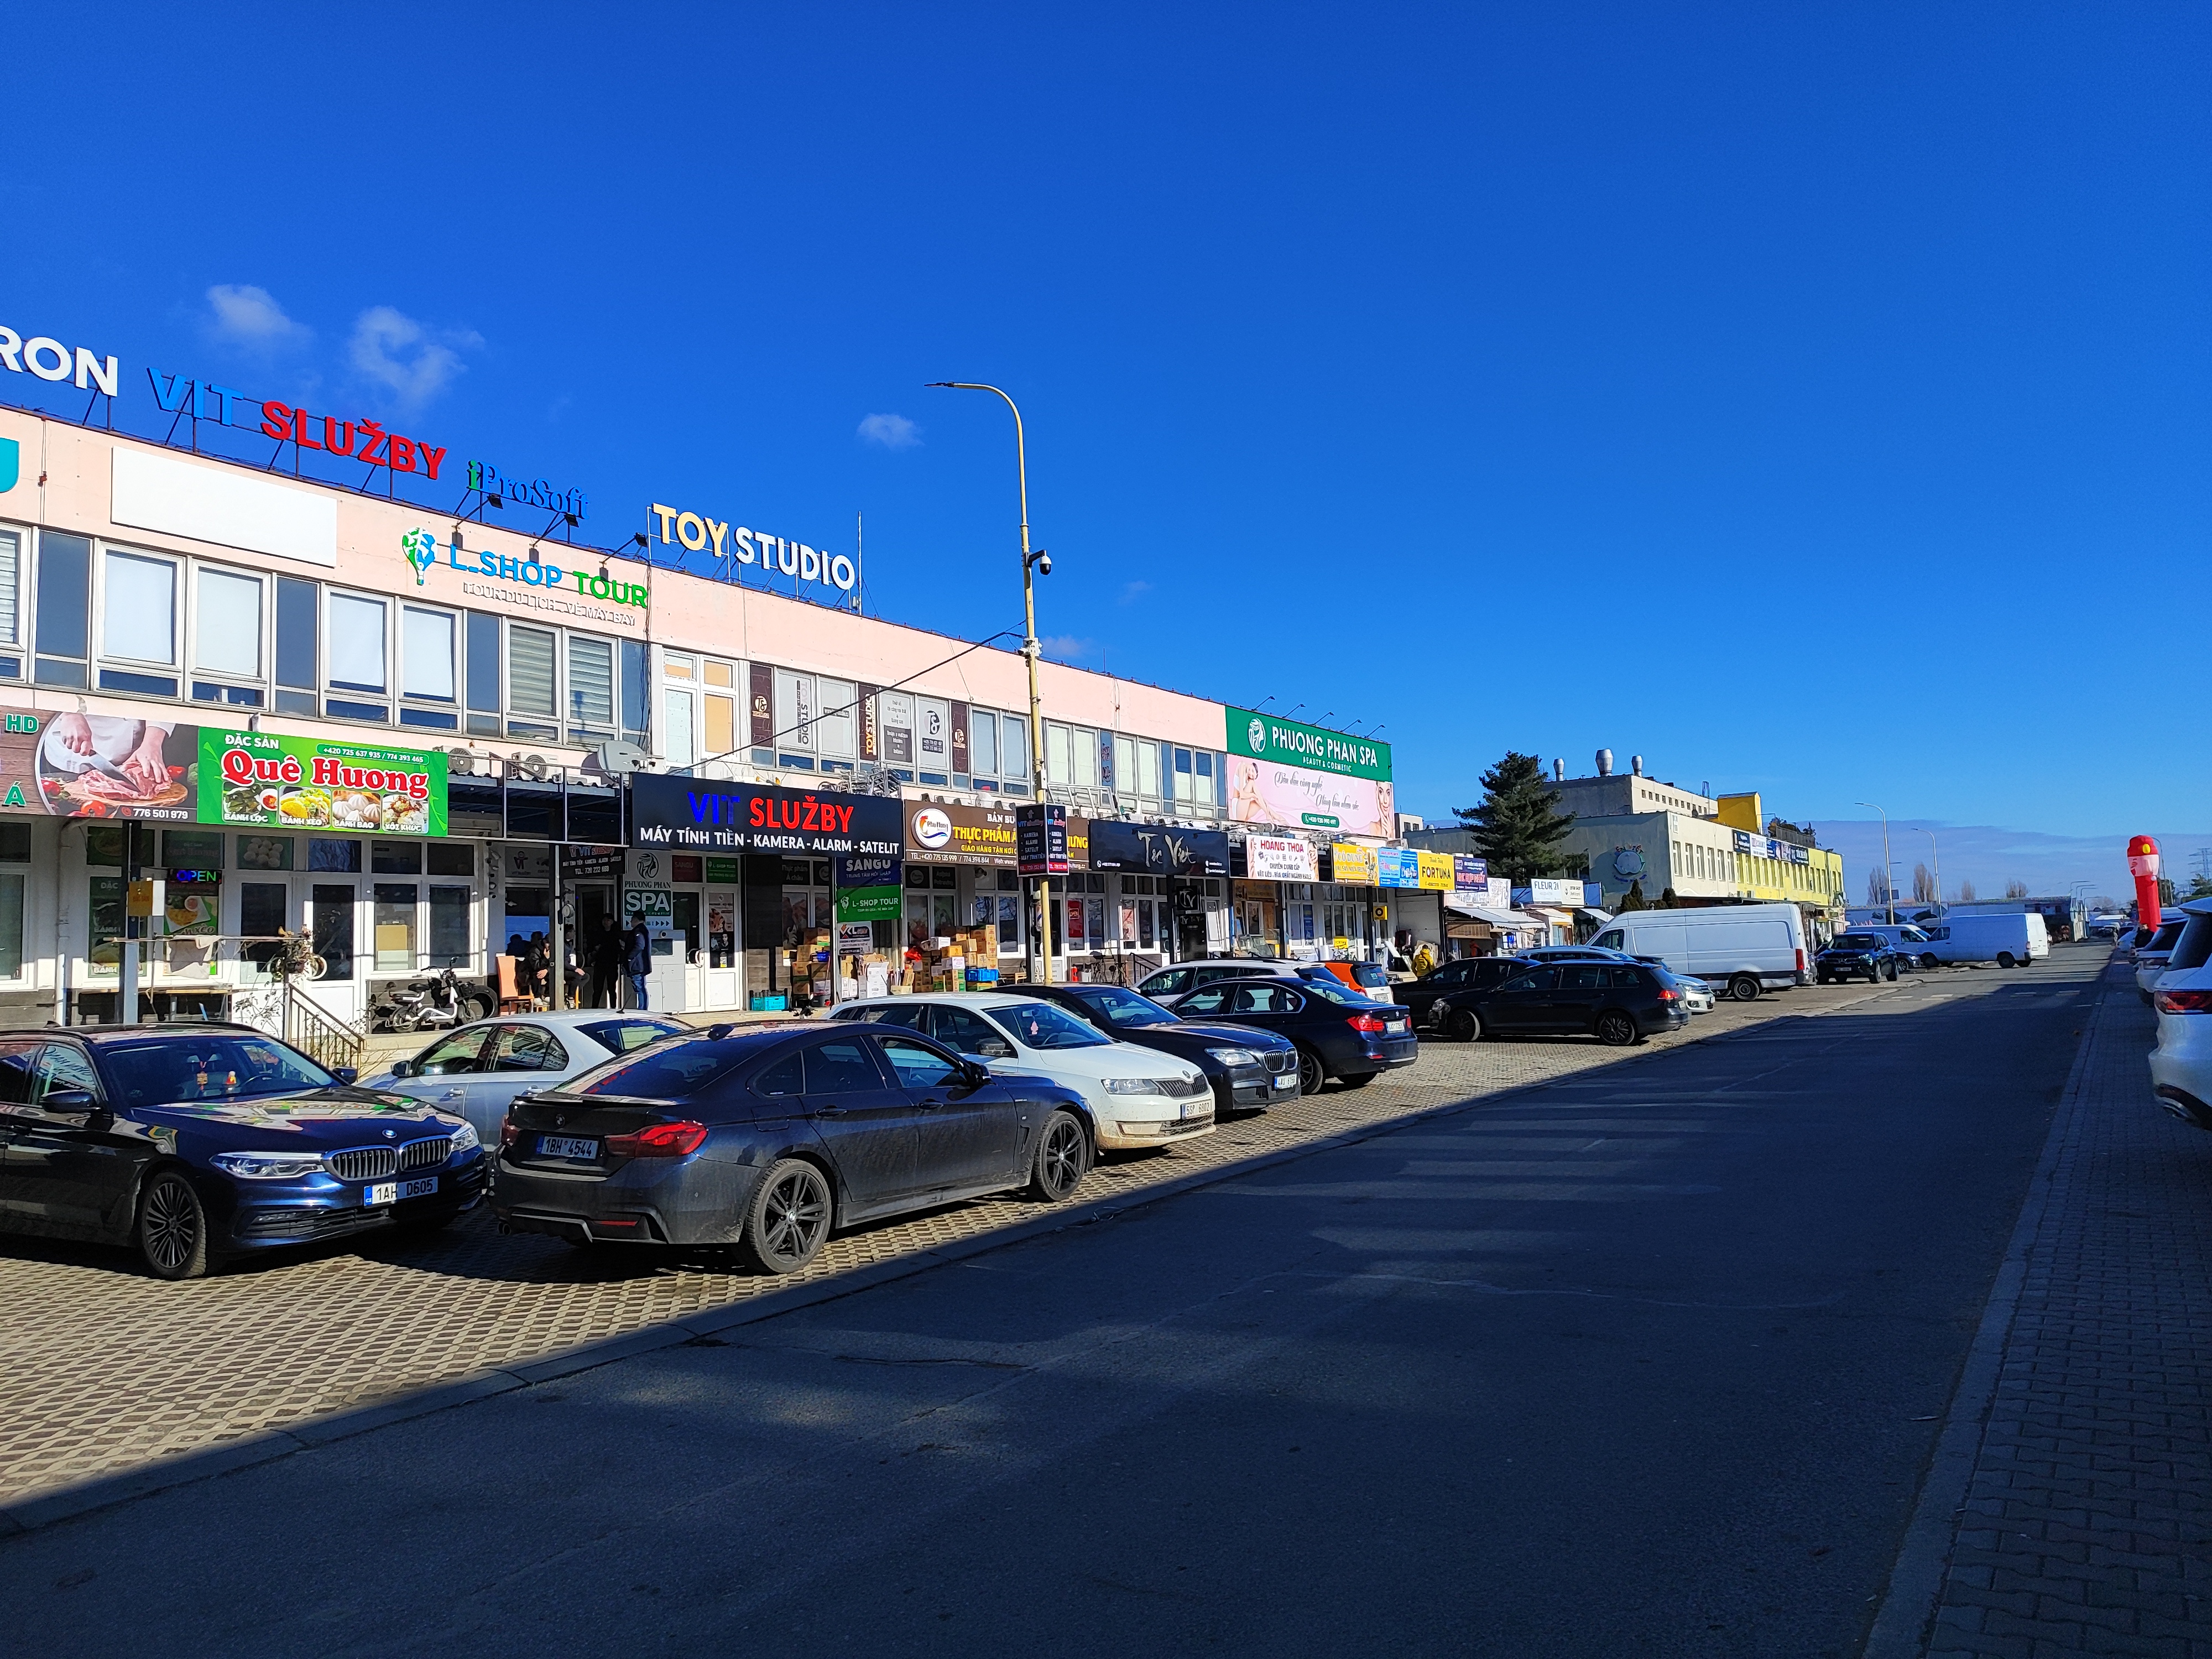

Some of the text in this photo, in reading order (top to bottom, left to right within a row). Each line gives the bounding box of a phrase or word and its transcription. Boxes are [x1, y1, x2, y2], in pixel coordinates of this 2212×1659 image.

[148, 367, 447, 479] VIT SLUŽBY
[467, 460, 589, 520] iProSoft
[653, 503, 855, 591] TOY STUDIO
[463, 582, 500, 601] TOUR
[573, 571, 648, 608] TOUR
[5, 713, 39, 733] HD
[225, 733, 252, 749] ĐẶC
[1272, 726, 1378, 767] PHUONG PHAN SPA
[222, 749, 302, 785] Quê
[1303, 756, 1322, 767] BEAUTY
[2, 781, 27, 807] Á
[133, 808, 189, 820] 776 501 979
[224, 812, 249, 821] BÁNH
[281, 816, 305, 825] BÁNH
[687, 792, 854, 833] VIT SLUŽBY
[1005, 815, 1016, 824] BU
[334, 820, 356, 828] BÁNH
[640, 825, 672, 842] MÁY
[676, 826, 709, 844] TÍNH
[714, 827, 744, 847] TIỀN
[754, 834, 805, 850] KAMERA
[812, 837, 852, 852] ALARM
[859, 840, 900, 855] SATELIT
[1261, 838, 1304, 852] HOÀNG THOA
[846, 859, 891, 872] SANGU
[1422, 867, 1452, 879] FORTUNA
[177, 870, 216, 881] OPEN
[1534, 881, 1553, 890] FLEUR
[626, 892, 670, 911] SPA
[1186, 1105, 1195, 1115] 5SP
[546, 1138, 592, 1157] 1BH 4544
[376, 1186, 397, 1201] 1AH
